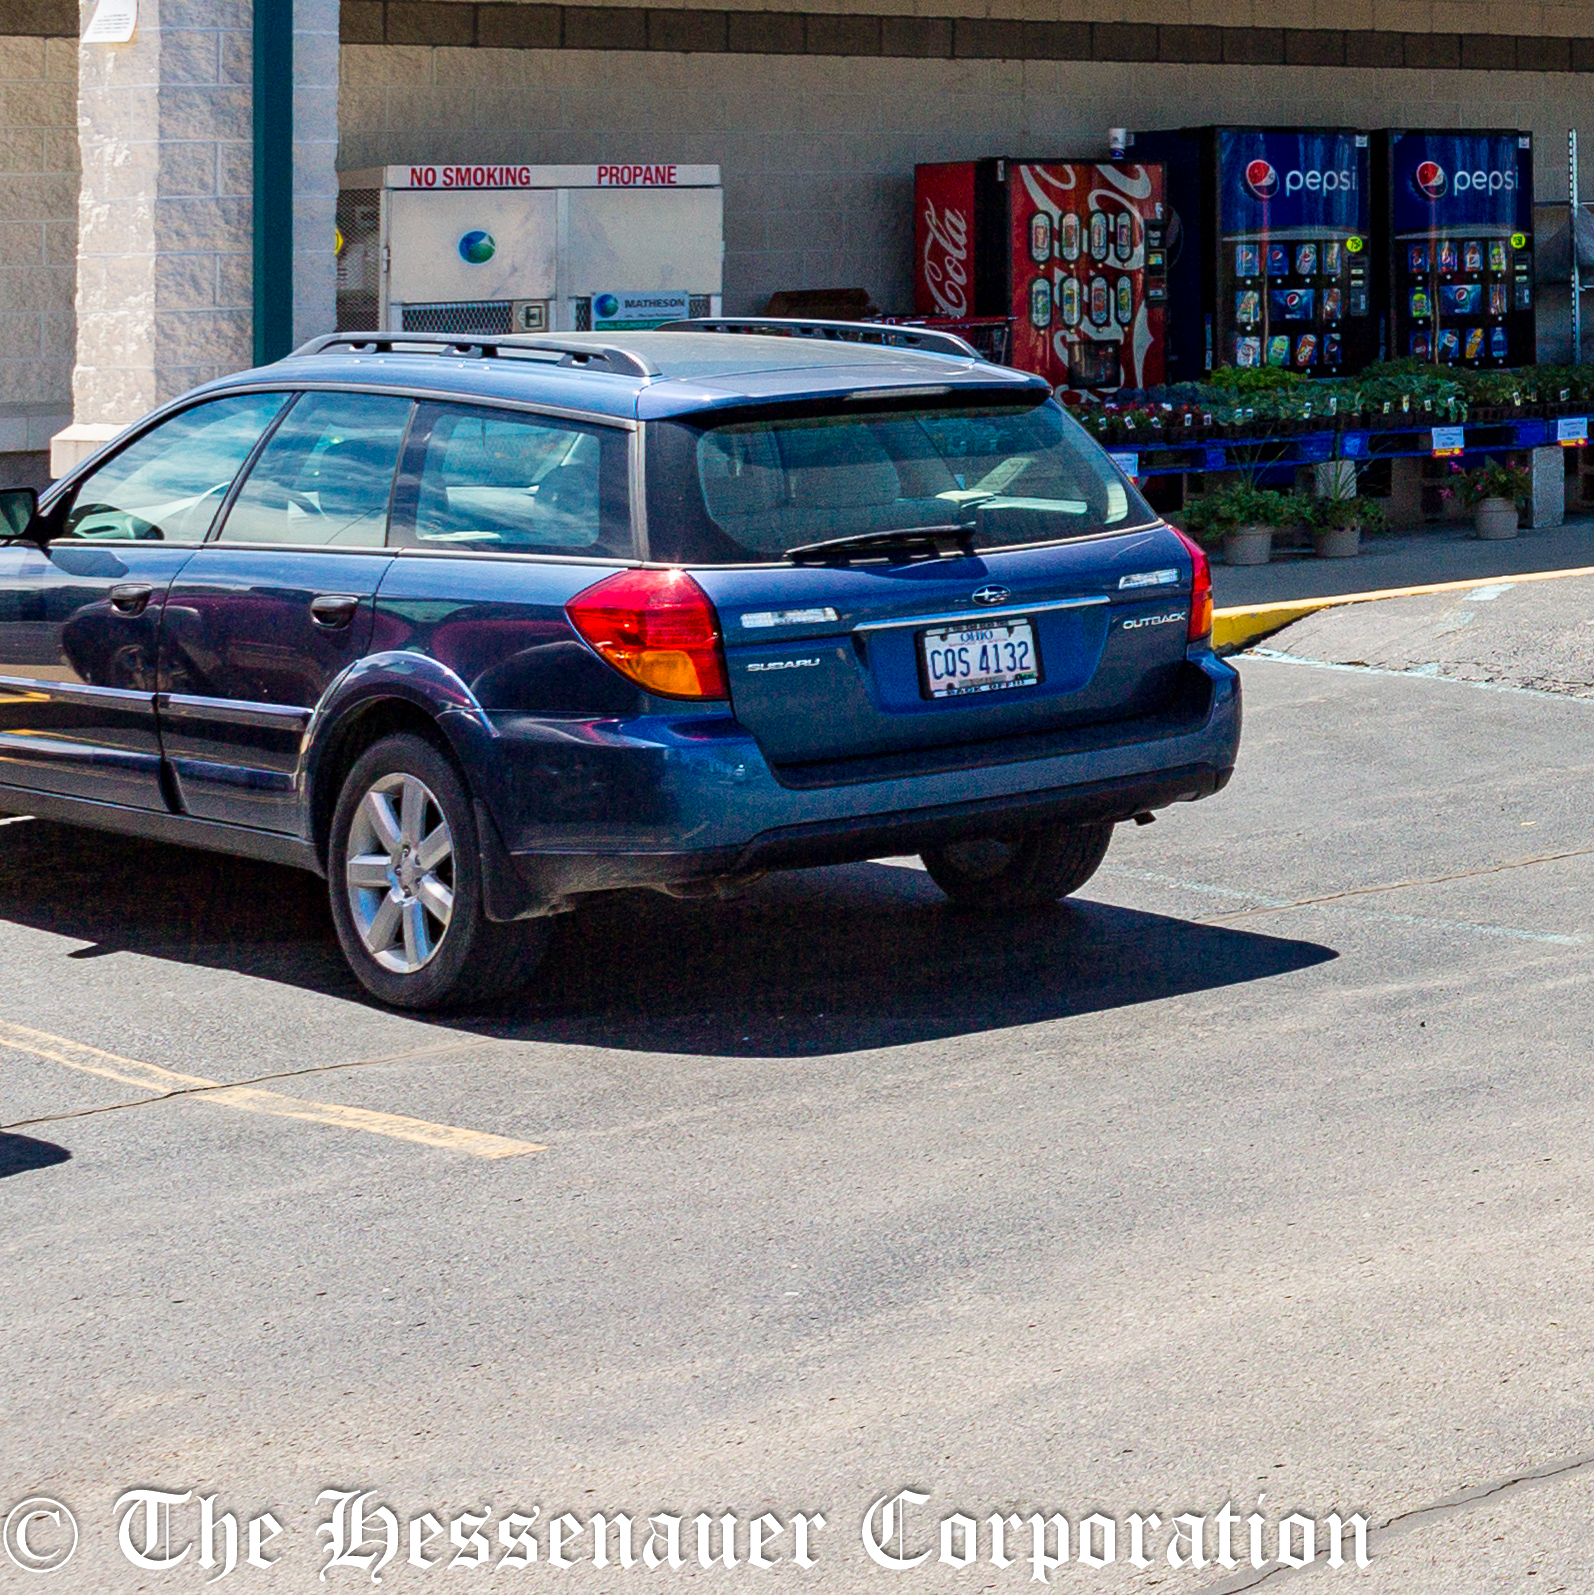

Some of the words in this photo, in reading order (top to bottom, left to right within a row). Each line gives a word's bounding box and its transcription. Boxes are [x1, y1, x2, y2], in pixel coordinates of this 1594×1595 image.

[410, 167, 437, 187] NO
[442, 166, 531, 186] SMOKING
[597, 165, 678, 185] PROPANE
[1286, 166, 1357, 197] pepsi
[1454, 166, 1519, 197] pepsi
[624, 298, 685, 309] MATHESON
[1122, 611, 1187, 630] OUTBACK
[960, 629, 994, 642] OHIO
[747, 657, 821, 672] SUBARU
[930, 646, 970, 680] CQS
[979, 640, 1031, 675] 4132
